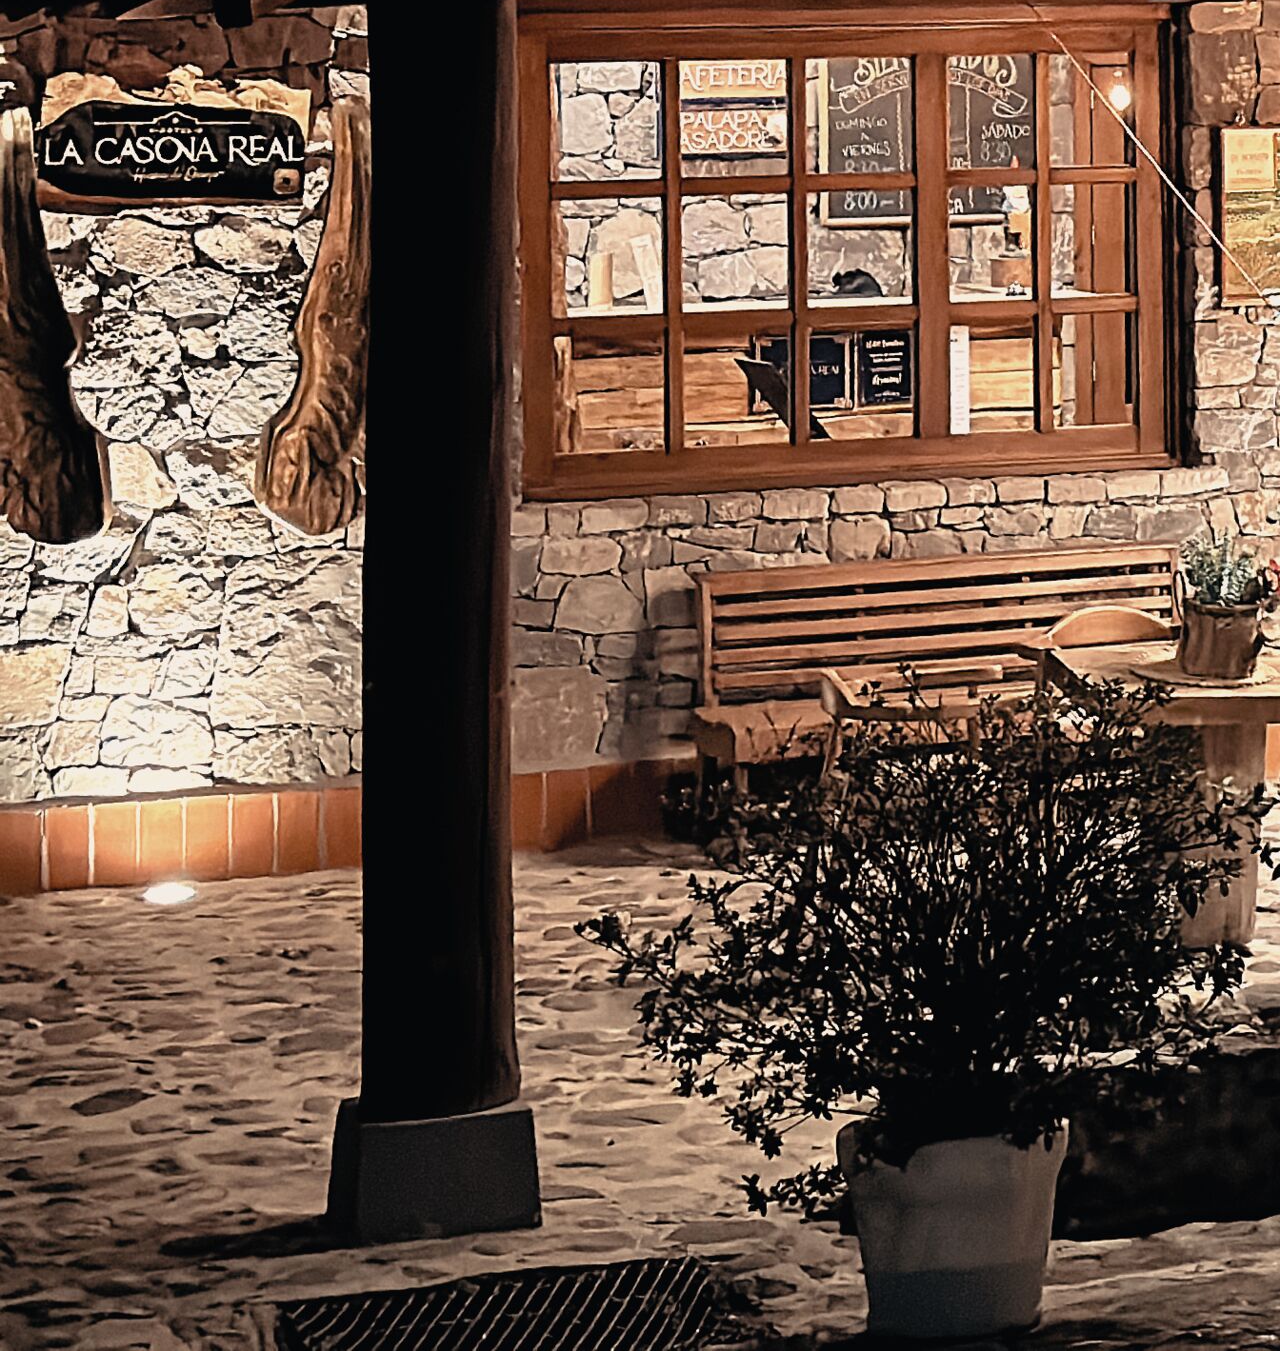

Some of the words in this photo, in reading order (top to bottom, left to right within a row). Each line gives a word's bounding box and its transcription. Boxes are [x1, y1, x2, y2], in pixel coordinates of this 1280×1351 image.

[680, 61, 786, 91] AFETERIA
[44, 138, 84, 166] LA
[94, 135, 219, 166] CASONA
[228, 134, 305, 166] REAL
